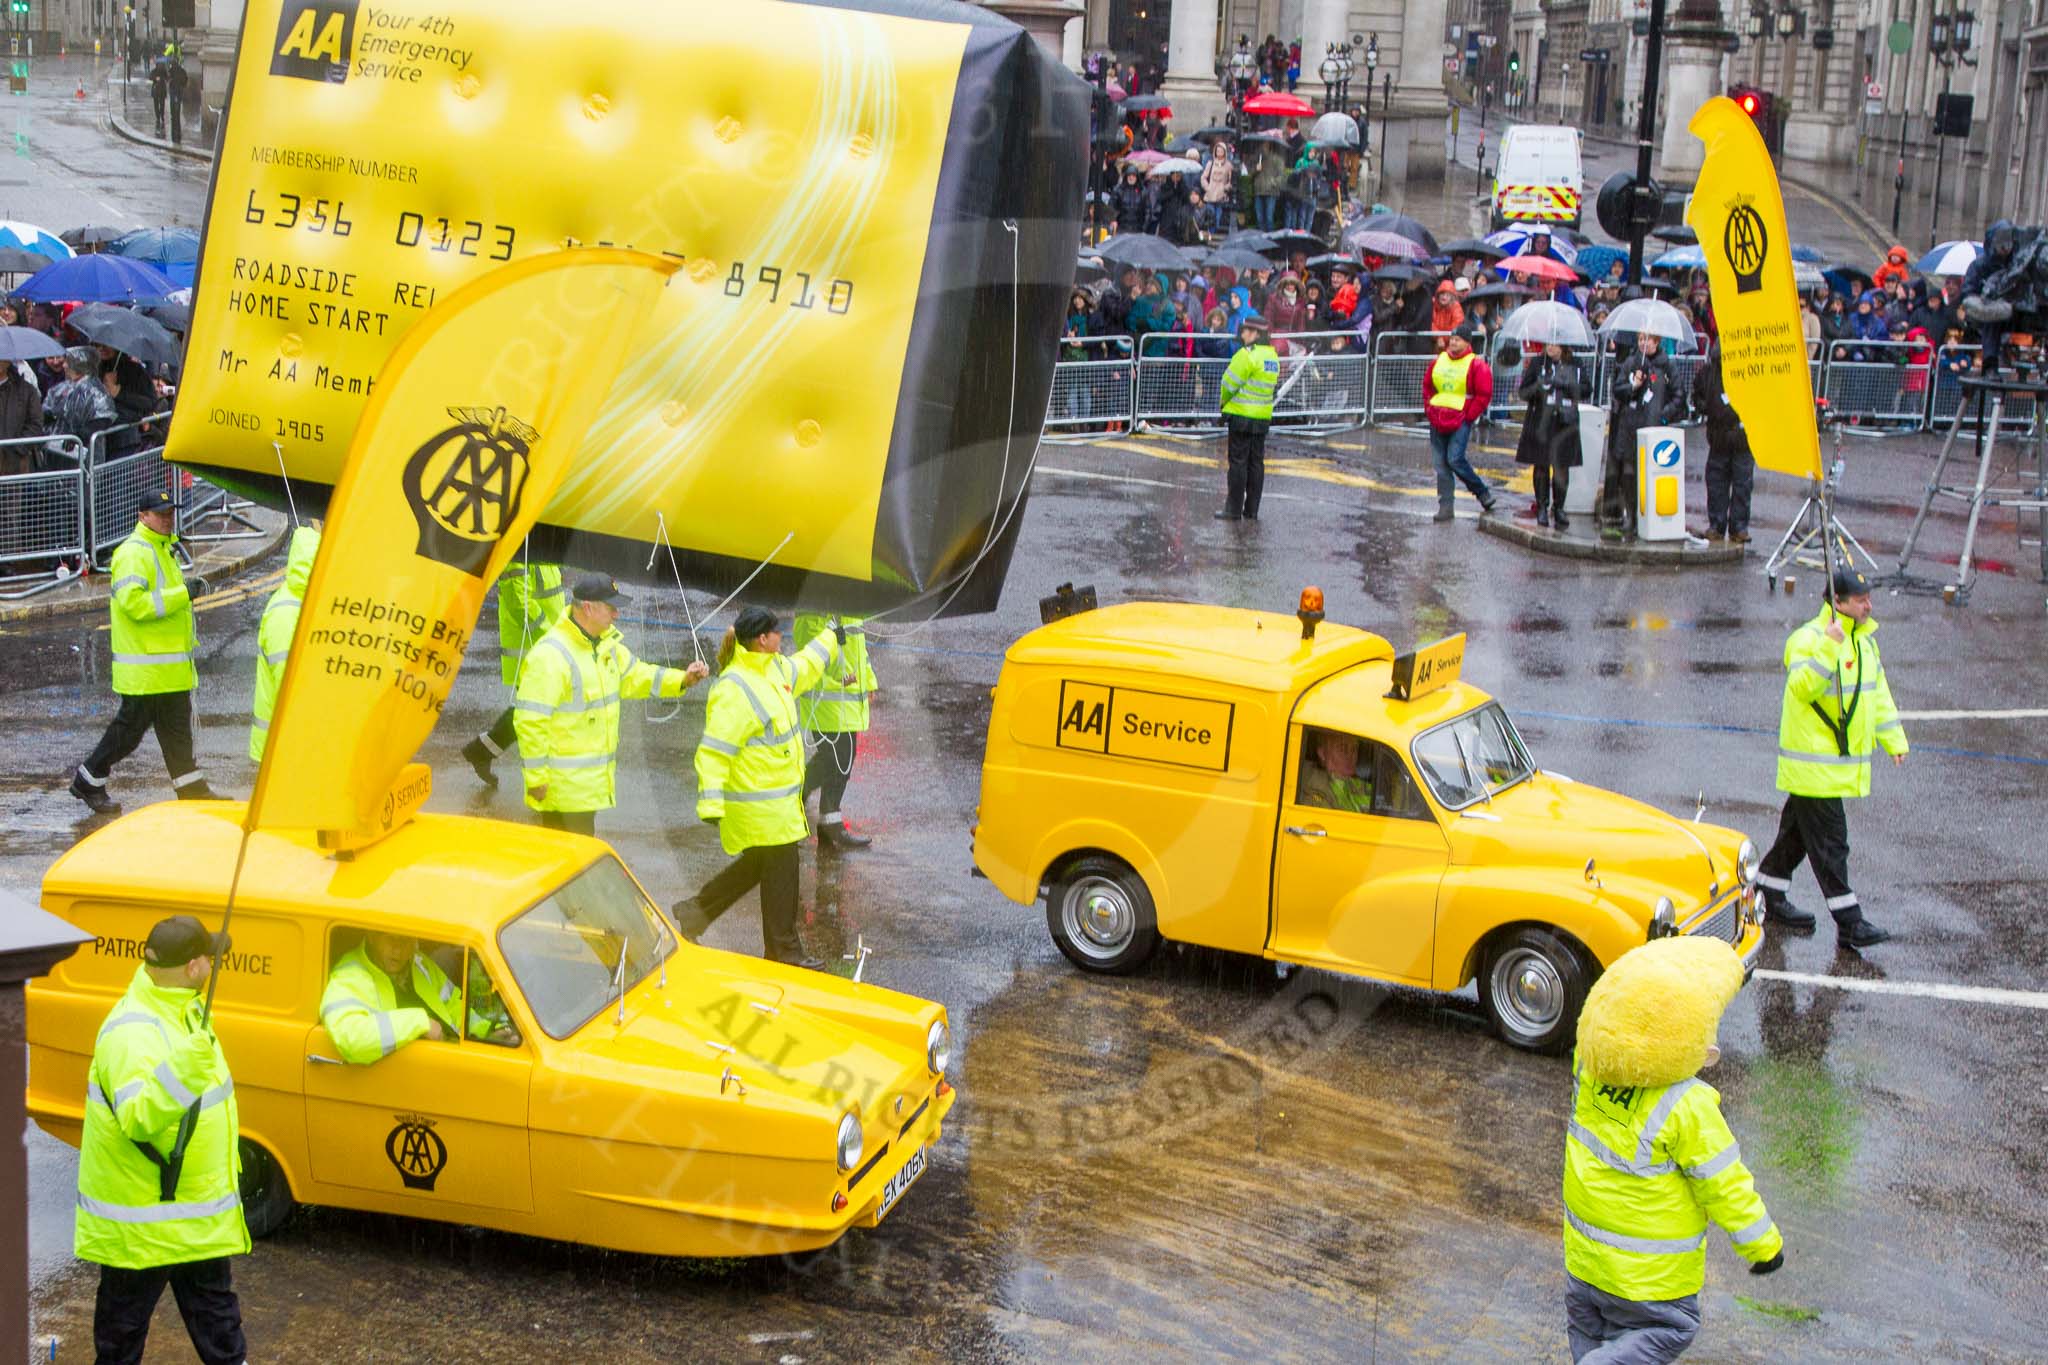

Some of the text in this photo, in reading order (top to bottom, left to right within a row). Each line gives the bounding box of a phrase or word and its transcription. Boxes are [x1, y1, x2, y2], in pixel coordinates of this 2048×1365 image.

[279, 9, 345, 64] AA
[367, 8, 455, 36] Your 4th
[354, 58, 422, 83] Service
[360, 33, 473, 71] Emergency
[251, 146, 418, 183] MEMBERSHIP NUMBER
[245, 189, 352, 236] 6356
[396, 211, 516, 261] 0123
[724, 262, 854, 314] 8910
[233, 257, 357, 297] ROADSIDE
[229, 290, 389, 336] HOME START
[219, 349, 248, 373] Mr
[269, 358, 296, 382] AA
[208, 408, 324, 442] JOINED 1905
[330, 596, 427, 635] Helping
[309, 626, 422, 663] motorists
[325, 654, 382, 682] than
[394, 669, 427, 701] 100
[1415, 655, 1461, 686] AA Service
[1063, 699, 1212, 745] AA Service
[397, 774, 430, 808] SERVICE
[94, 936, 147, 960] PATRO
[899, 1144, 925, 1189] 406K
